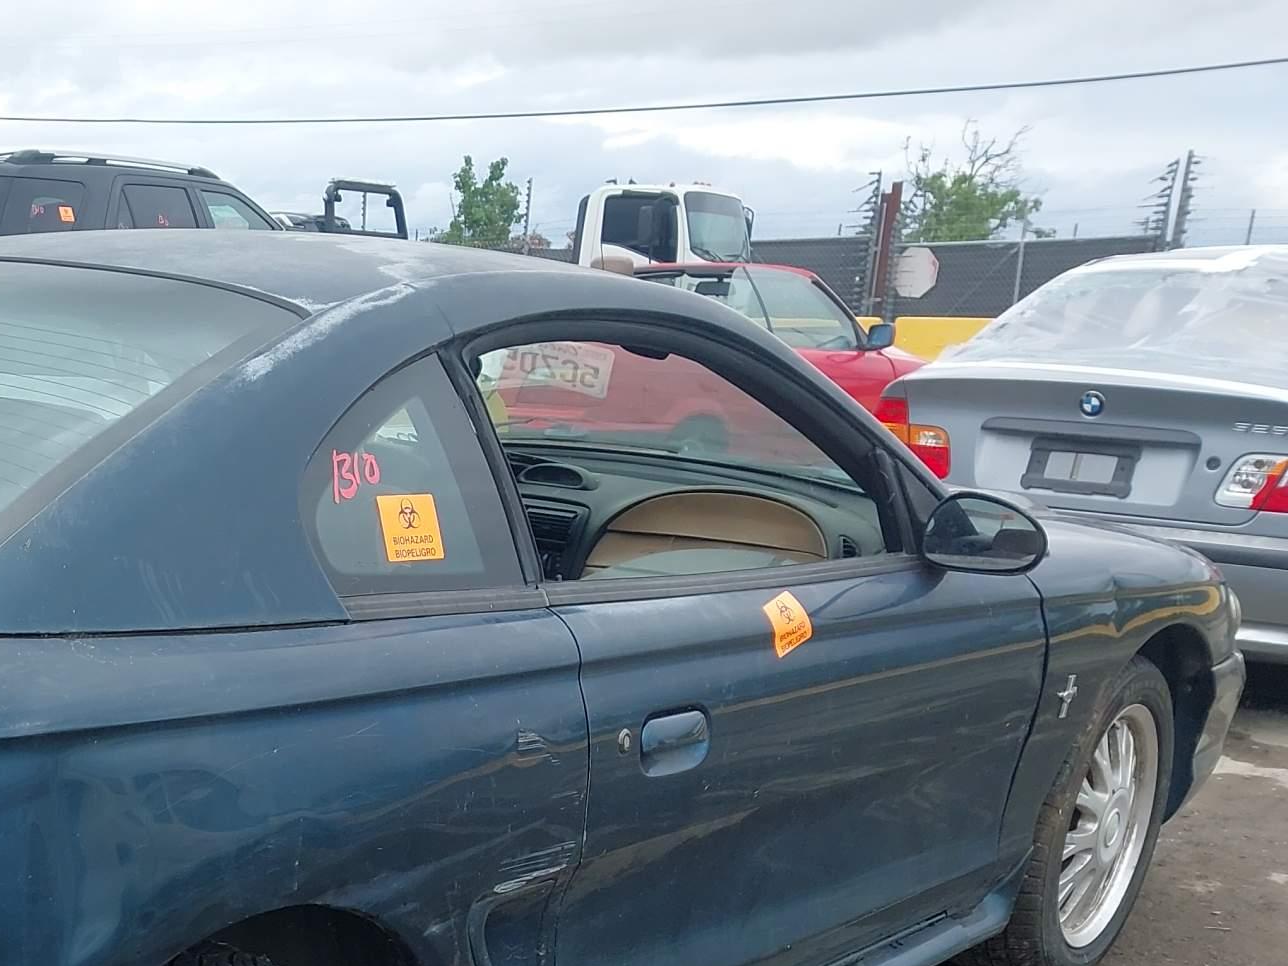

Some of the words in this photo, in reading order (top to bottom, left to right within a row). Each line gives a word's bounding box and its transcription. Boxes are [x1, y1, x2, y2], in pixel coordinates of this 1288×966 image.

[332, 449, 380, 504] BIO
[393, 535, 434, 546] BIOHAZARD
[395, 547, 437, 559] BIOPELIGRO
